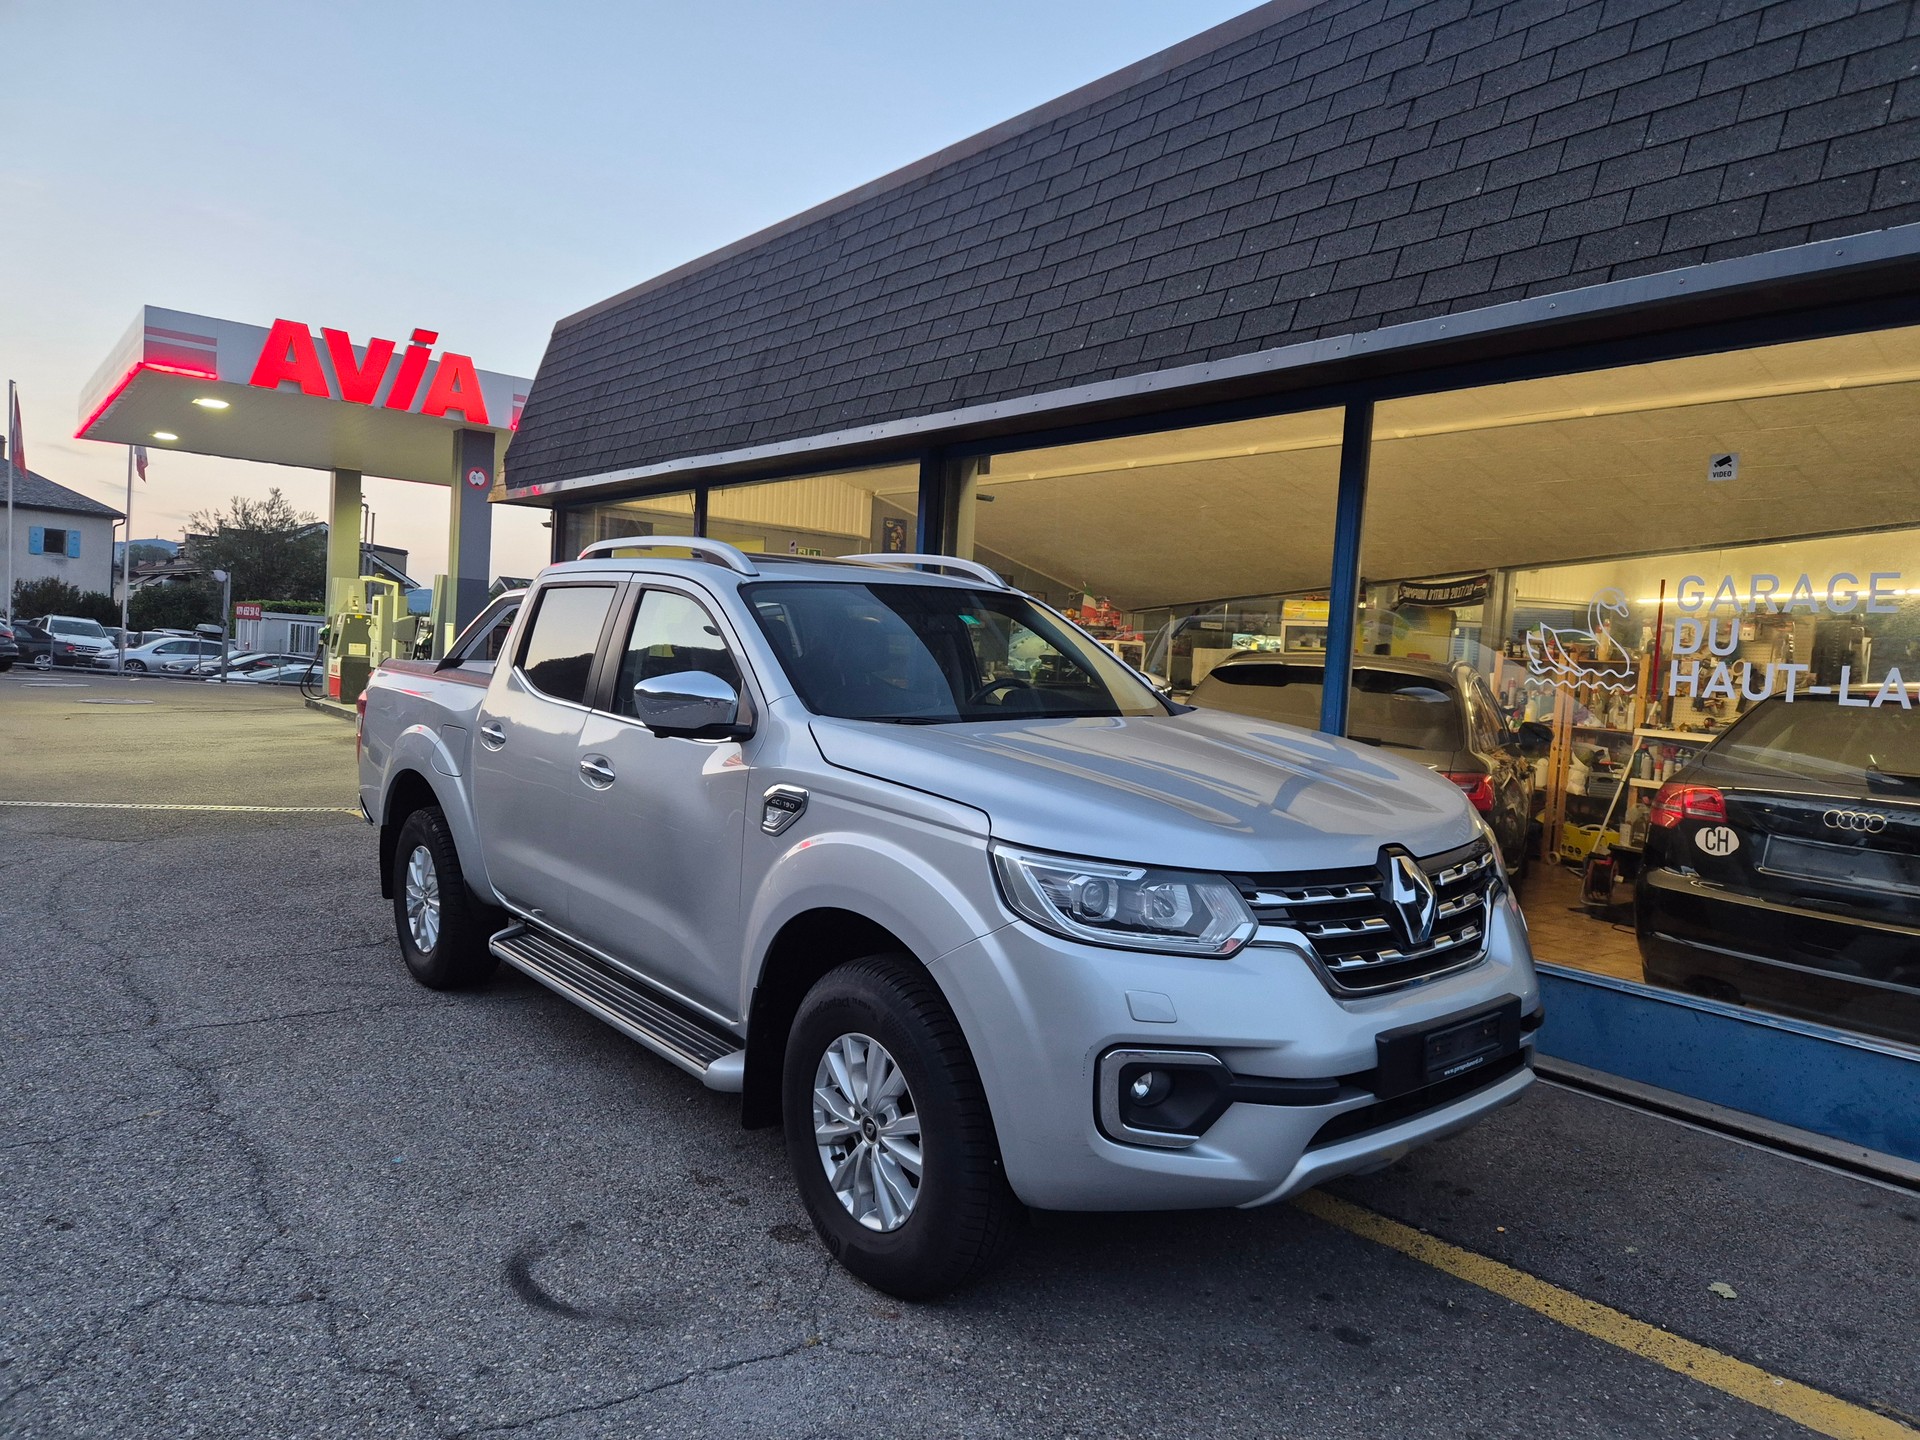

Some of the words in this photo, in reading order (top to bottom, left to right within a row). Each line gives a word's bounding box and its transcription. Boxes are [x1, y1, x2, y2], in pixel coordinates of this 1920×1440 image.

[1677, 572, 1901, 614] GARAGE
[1672, 617, 1740, 656] DU
[1668, 660, 1920, 710] HAUT-LA
[783, 801, 795, 809] 190
[1705, 829, 1729, 852] CH
